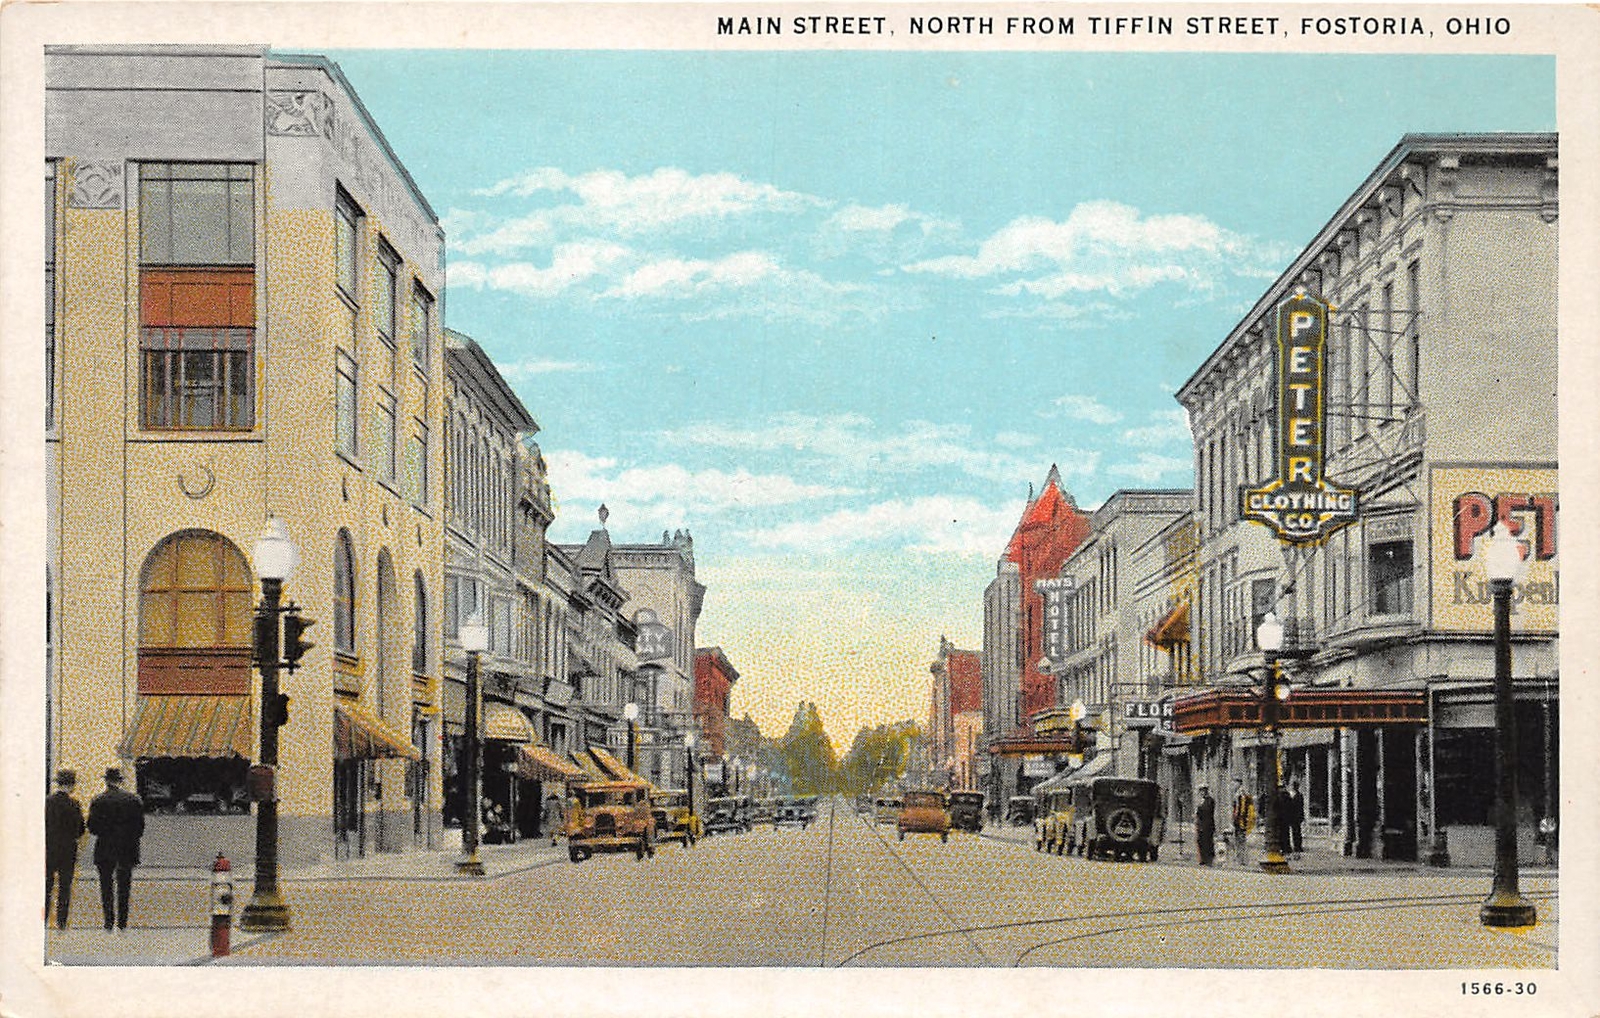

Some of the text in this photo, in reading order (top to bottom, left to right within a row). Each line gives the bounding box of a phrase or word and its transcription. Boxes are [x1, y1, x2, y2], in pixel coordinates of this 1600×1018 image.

[1289, 311, 1314, 483] PETER
[1249, 492, 1351, 510] CLOTHING
[1050, 591, 1060, 658] HOTEL
[1125, 703, 1173, 717] FLOR
